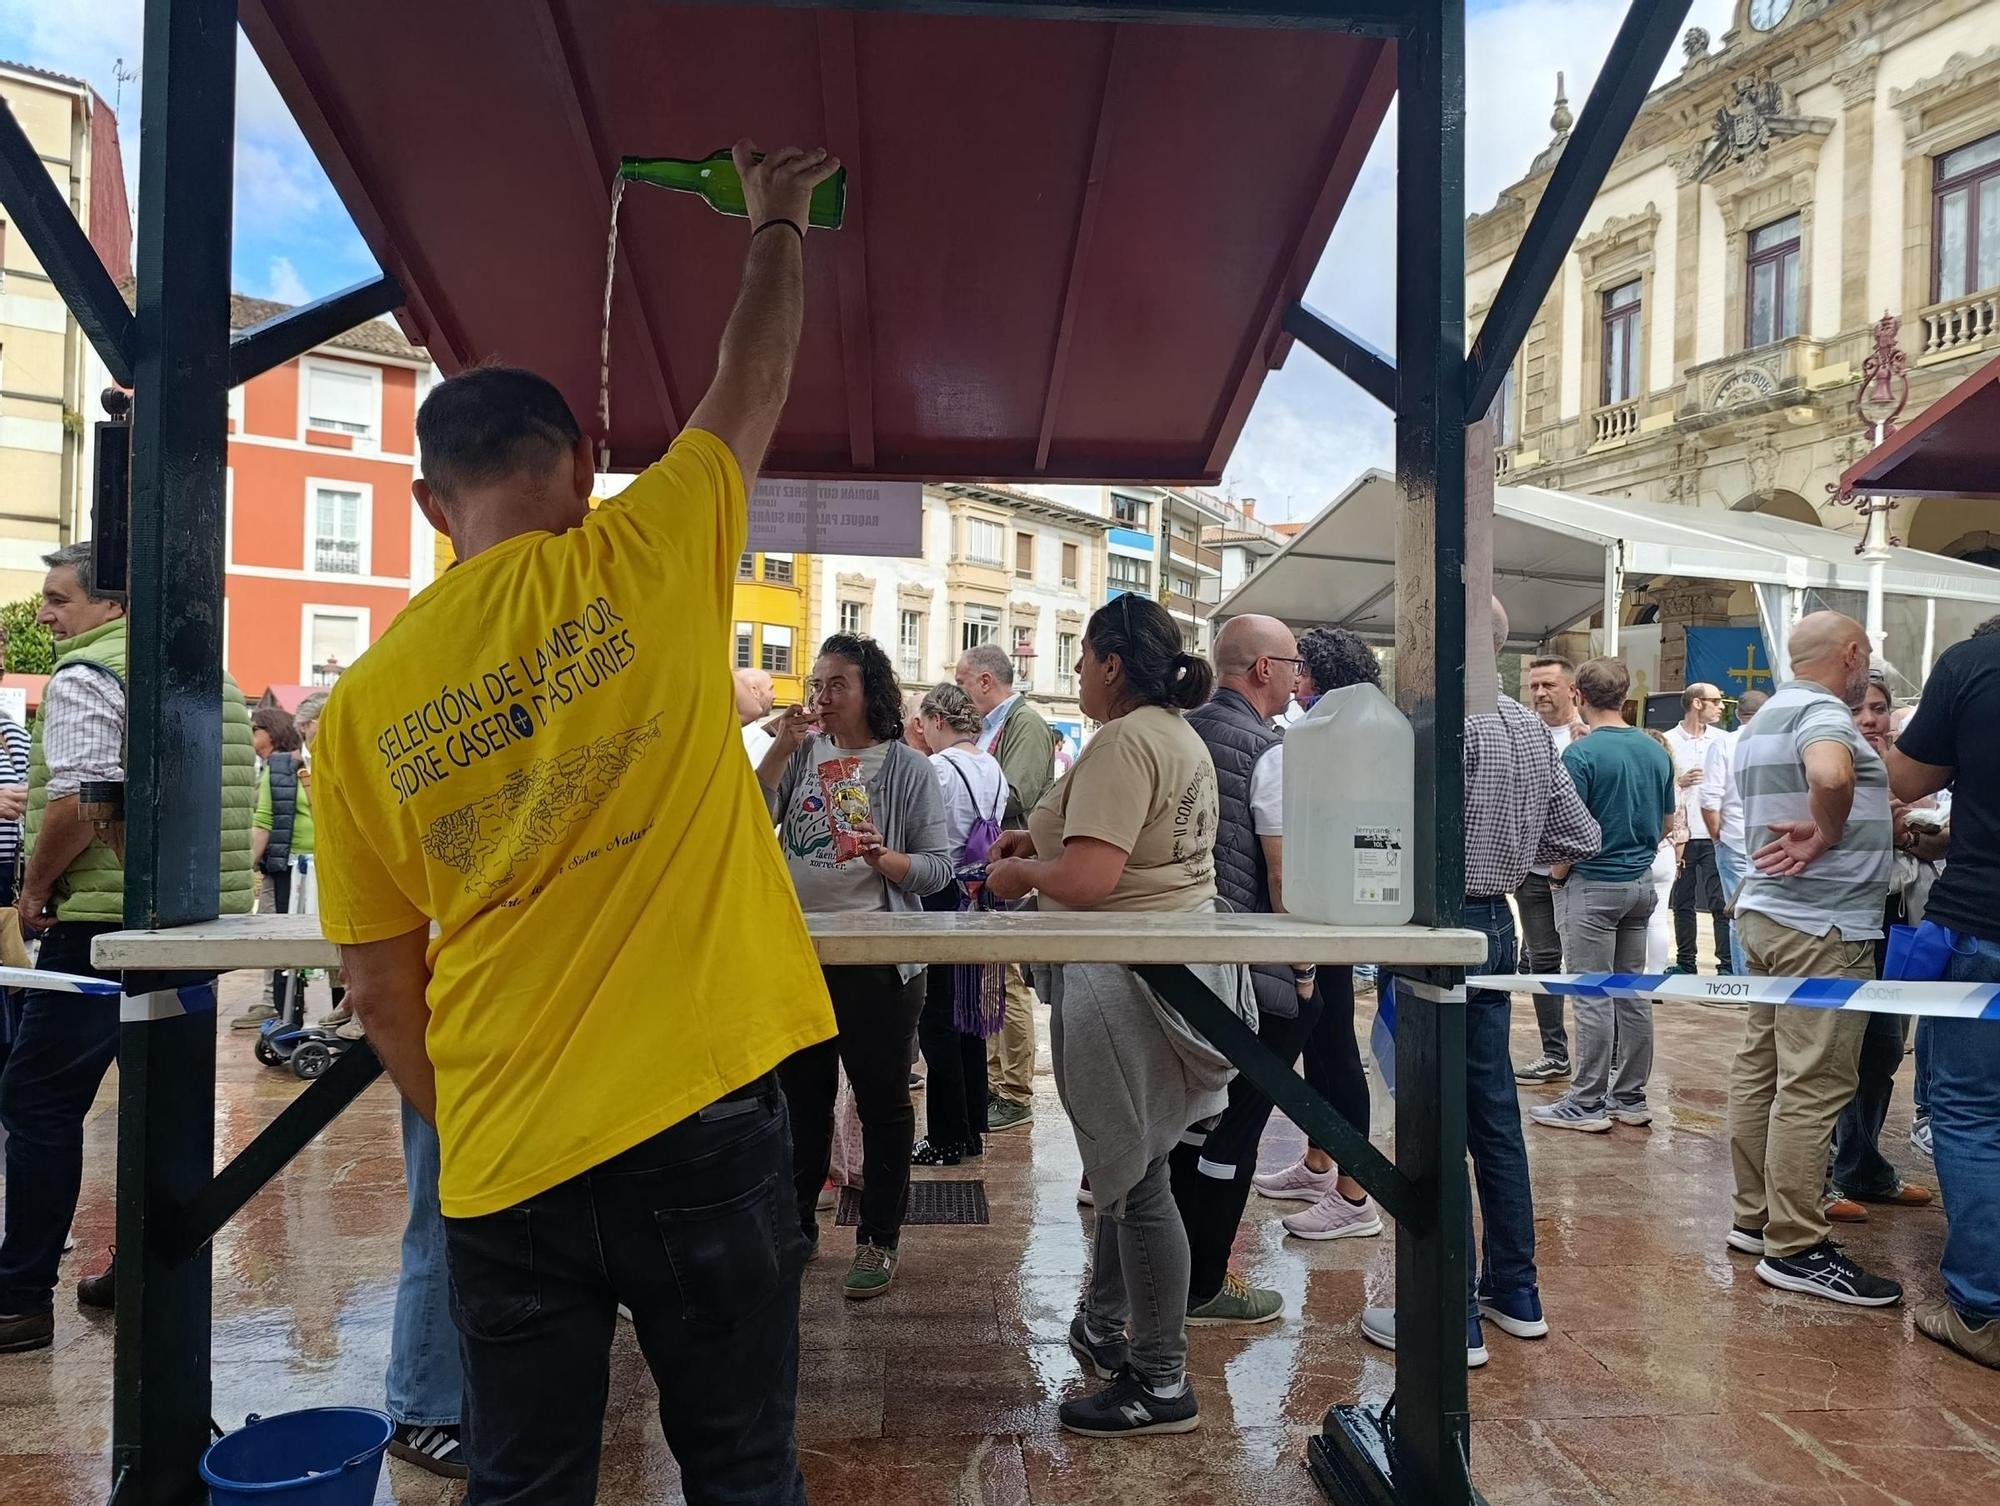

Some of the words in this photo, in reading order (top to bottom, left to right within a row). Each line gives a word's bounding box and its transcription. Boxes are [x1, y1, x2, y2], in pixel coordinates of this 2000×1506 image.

[377, 683, 483, 768] SELEICIÓN
[482, 662, 523, 705] DE
[519, 648, 547, 687] LA
[544, 597, 623, 667] MEYOR
[390, 745, 449, 804] SIDRE
[1705, 982, 1749, 996] LOCAL
[1120, 1401, 1153, 1426] N
